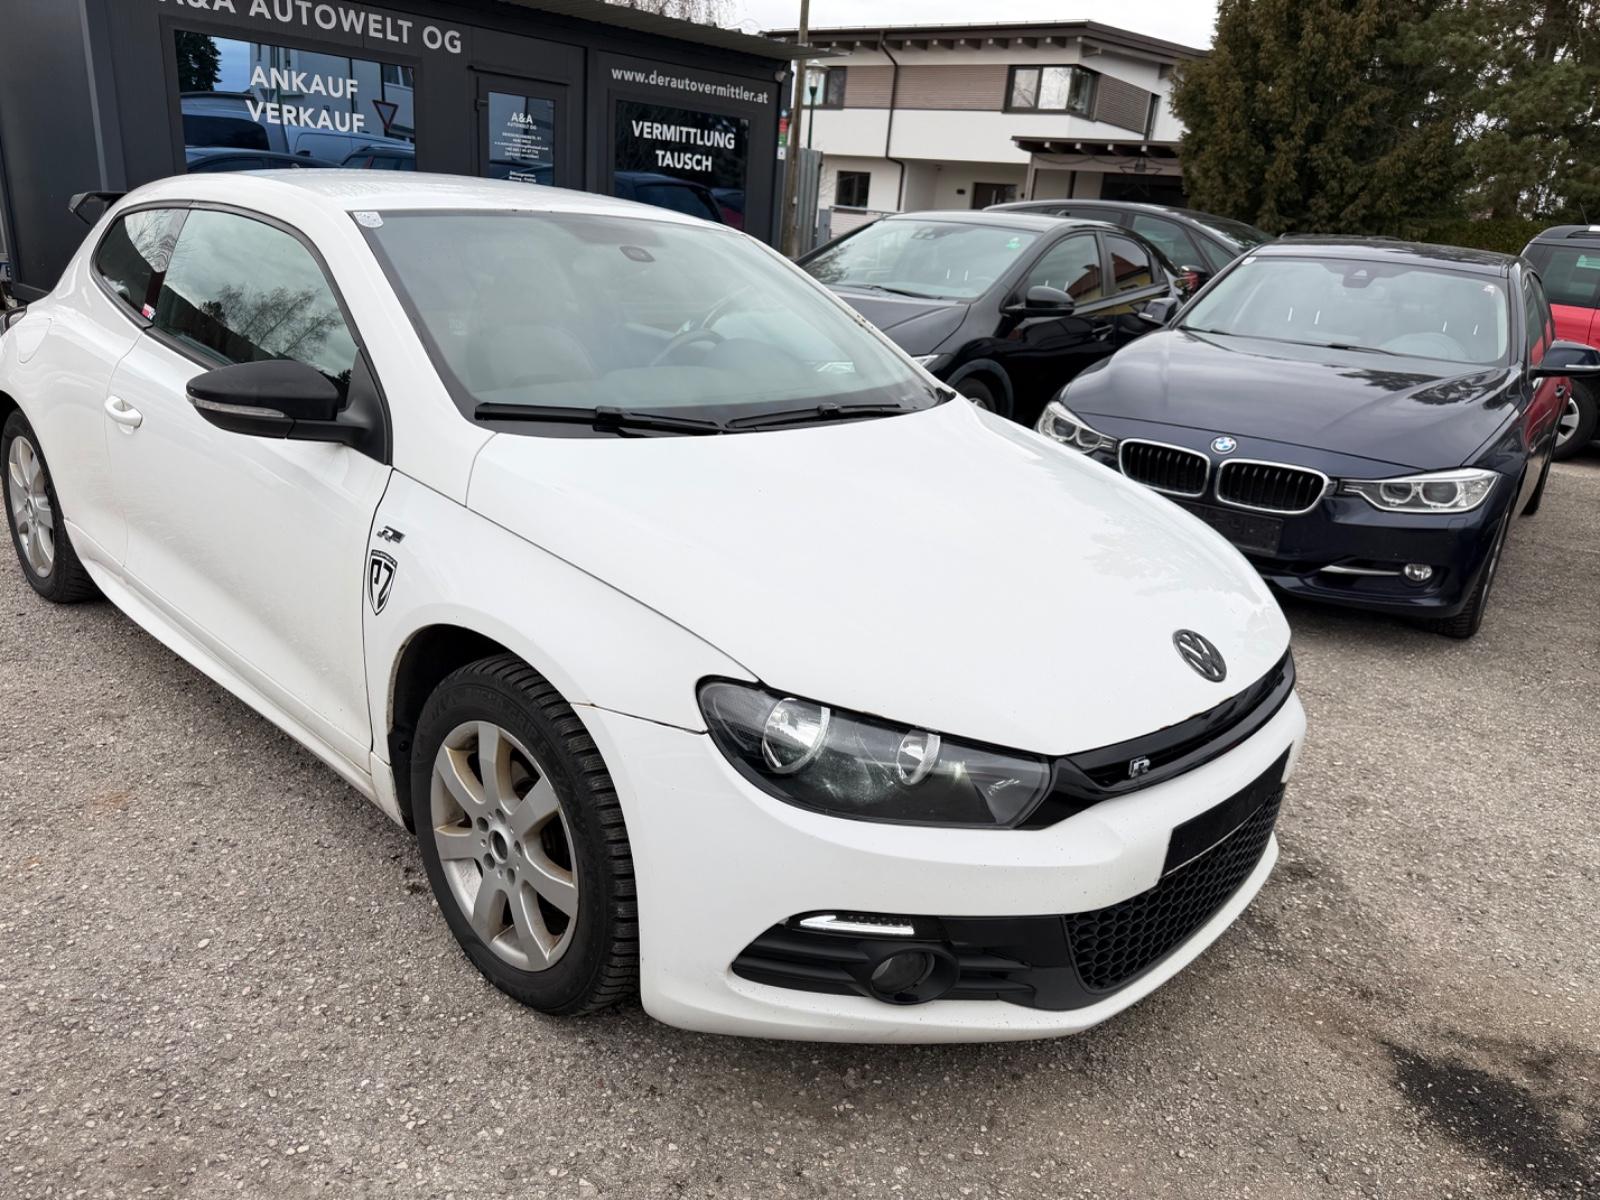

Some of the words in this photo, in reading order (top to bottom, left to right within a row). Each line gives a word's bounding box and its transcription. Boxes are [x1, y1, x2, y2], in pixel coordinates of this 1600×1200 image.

[249, 0, 413, 44] AUTOWELT
[423, 25, 461, 53] OG
[250, 65, 358, 99] ANKAUF
[611, 68, 768, 104] www.derautovermittler.at
[245, 100, 365, 133] VERKAUF
[511, 111, 533, 124] A&A
[631, 120, 735, 150] VERMITTLUNG
[656, 150, 712, 172] TAUSCH
